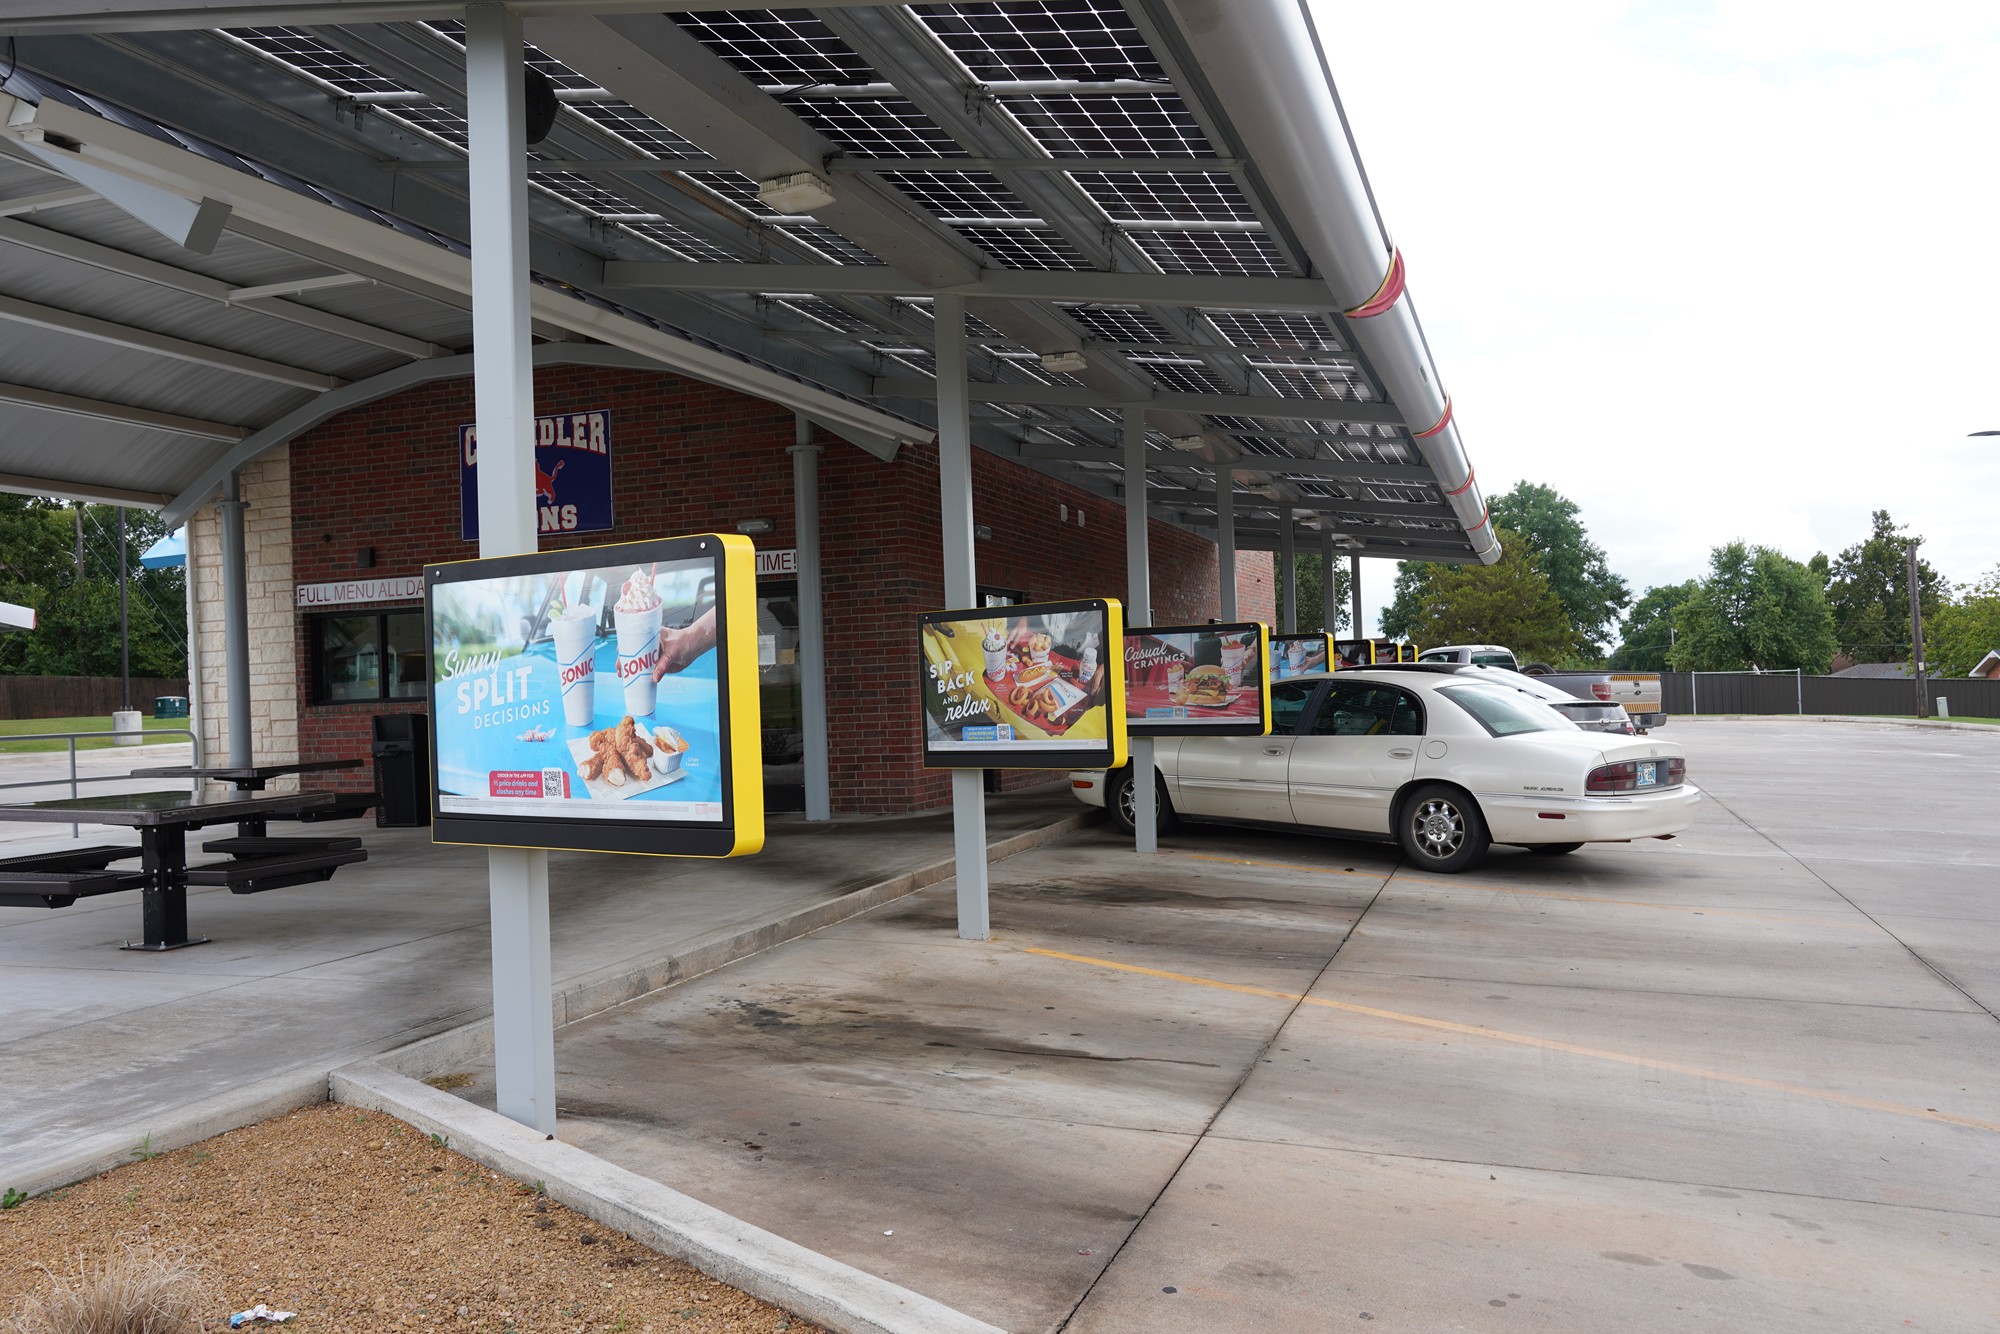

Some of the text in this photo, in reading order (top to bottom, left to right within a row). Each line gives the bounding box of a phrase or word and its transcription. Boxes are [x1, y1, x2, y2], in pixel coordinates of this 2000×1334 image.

[465, 413, 607, 466] CDLER
[298, 579, 425, 604] FULL MENU ALL DA
[441, 649, 502, 681] Sunny
[623, 649, 659, 679] SONIC
[1124, 641, 1168, 662] Casual
[1133, 652, 1186, 670] CRAVINGS
[561, 657, 594, 687] SONIC
[929, 660, 953, 679] SIP
[937, 670, 976, 694] BACK
[456, 665, 533, 715] SPLIT
[942, 694, 959, 706] AND
[474, 699, 550, 730] DECISIONS
[944, 693, 992, 722] relax
